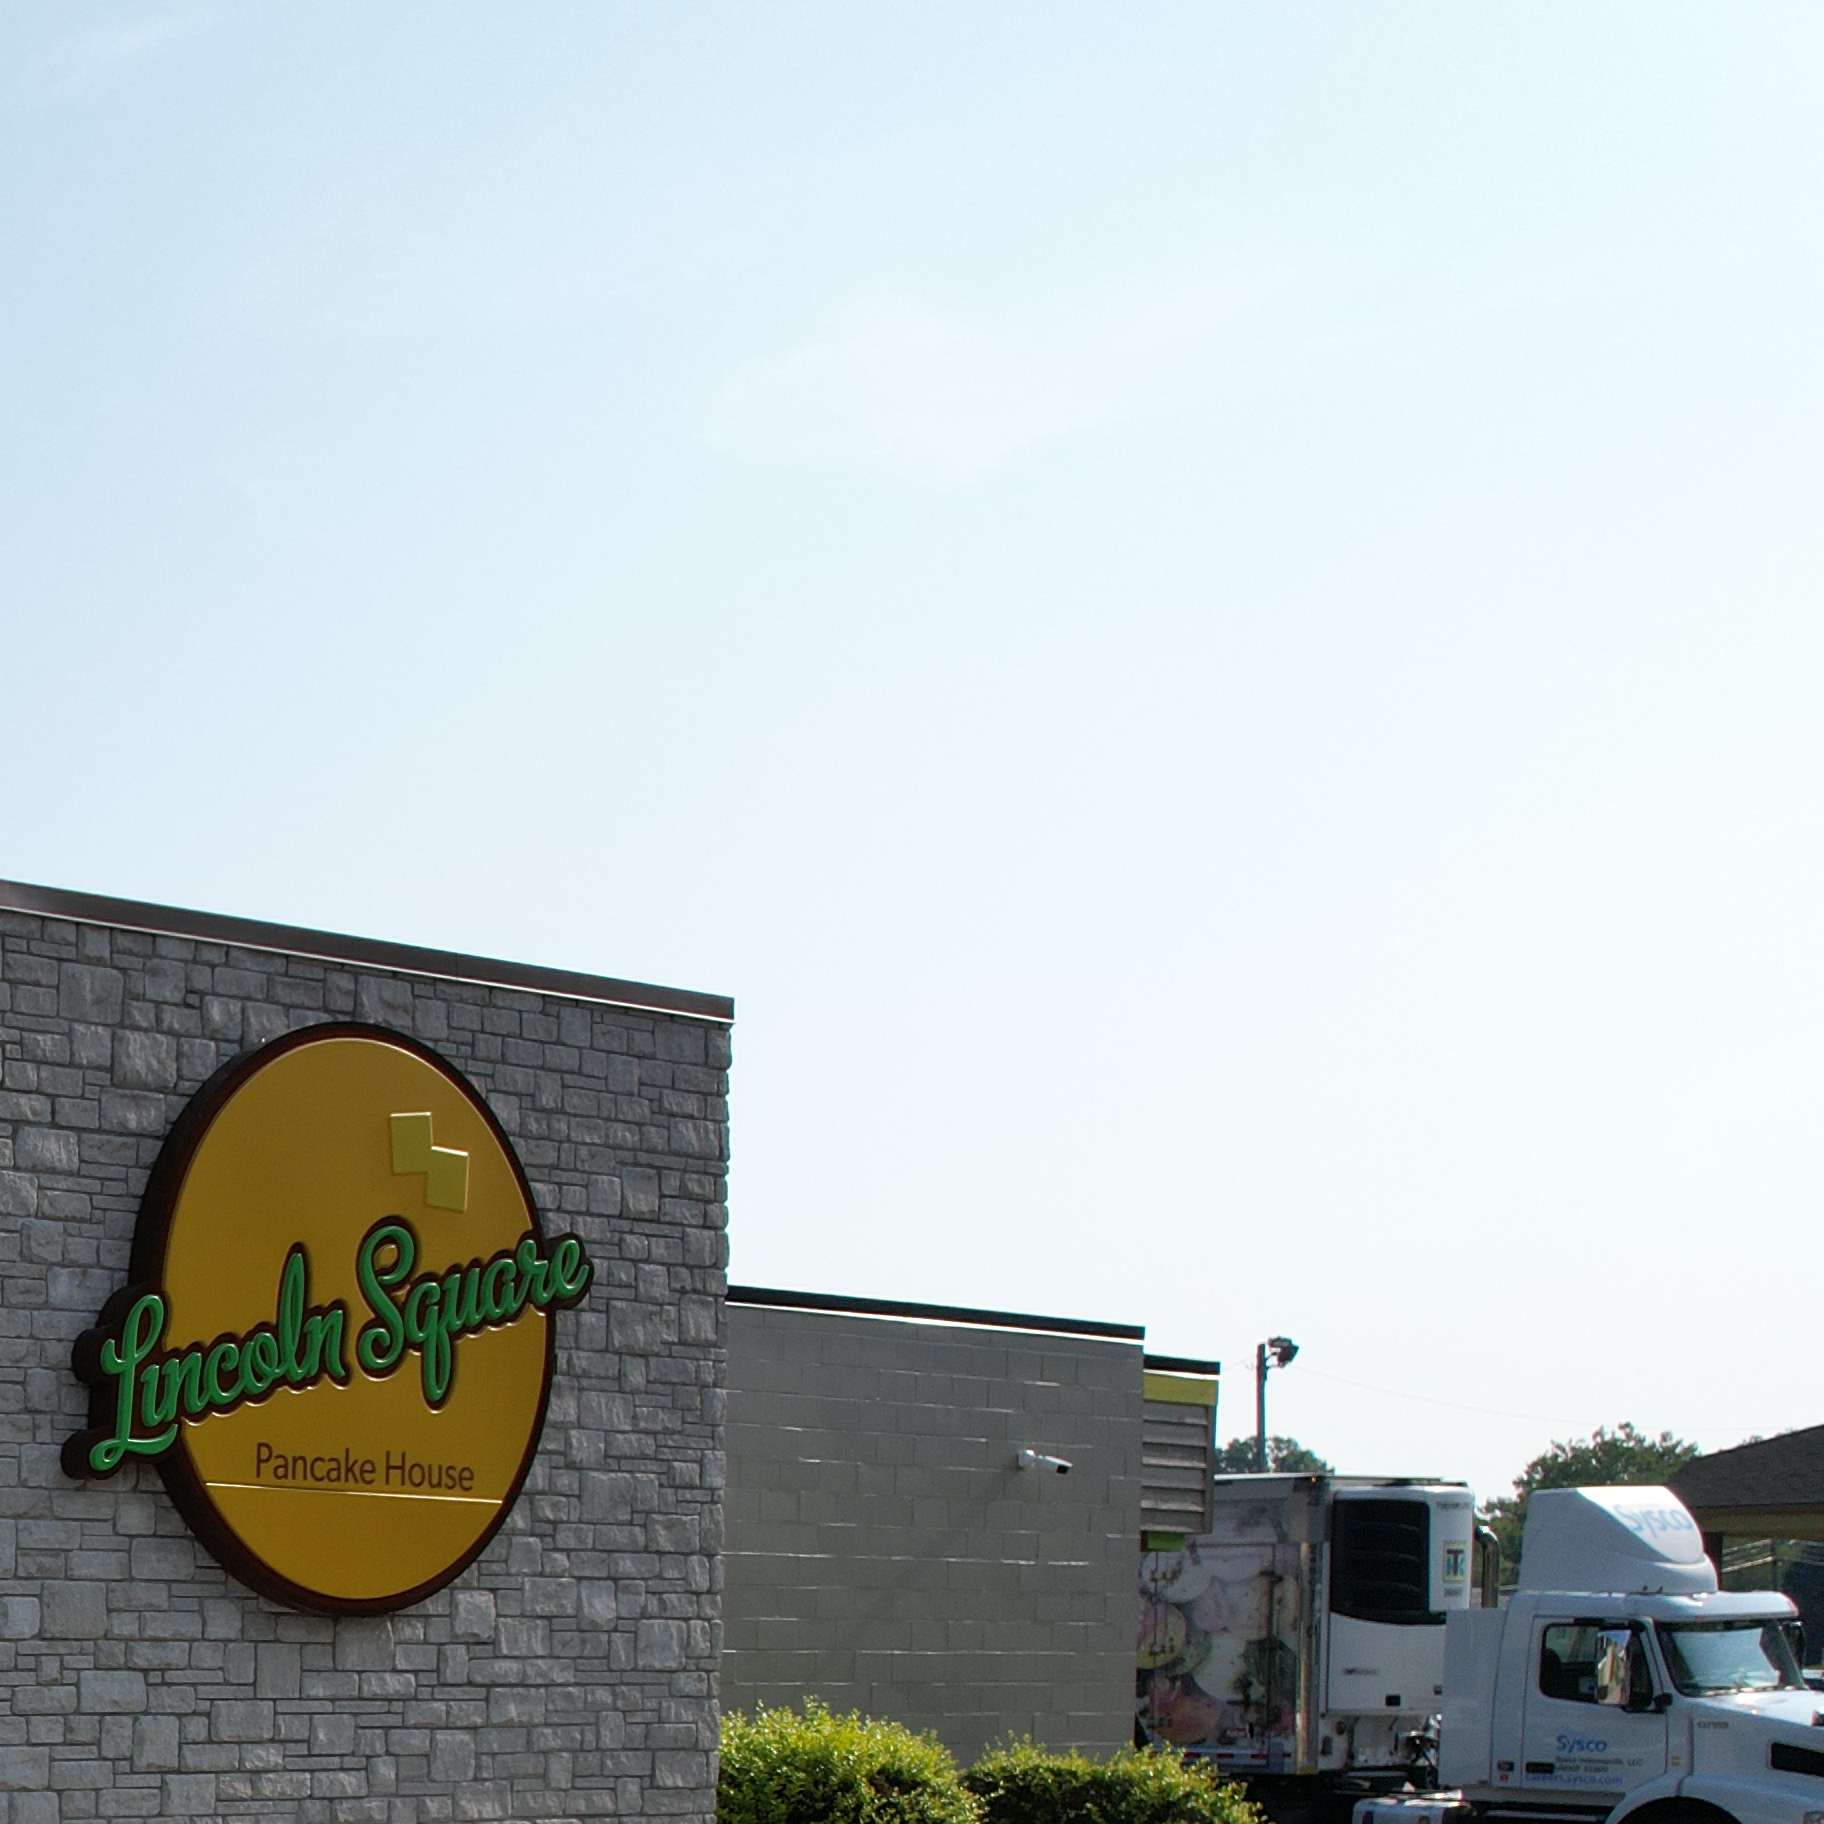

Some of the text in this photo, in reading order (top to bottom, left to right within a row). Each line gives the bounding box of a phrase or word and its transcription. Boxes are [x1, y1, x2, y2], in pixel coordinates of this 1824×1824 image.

[88, 1222, 593, 1473] Lincoln Square
[254, 1441, 476, 1493] Pancake House
[1612, 1502, 1695, 1540] Sysco
[1555, 1733, 1609, 1754] Sysco
